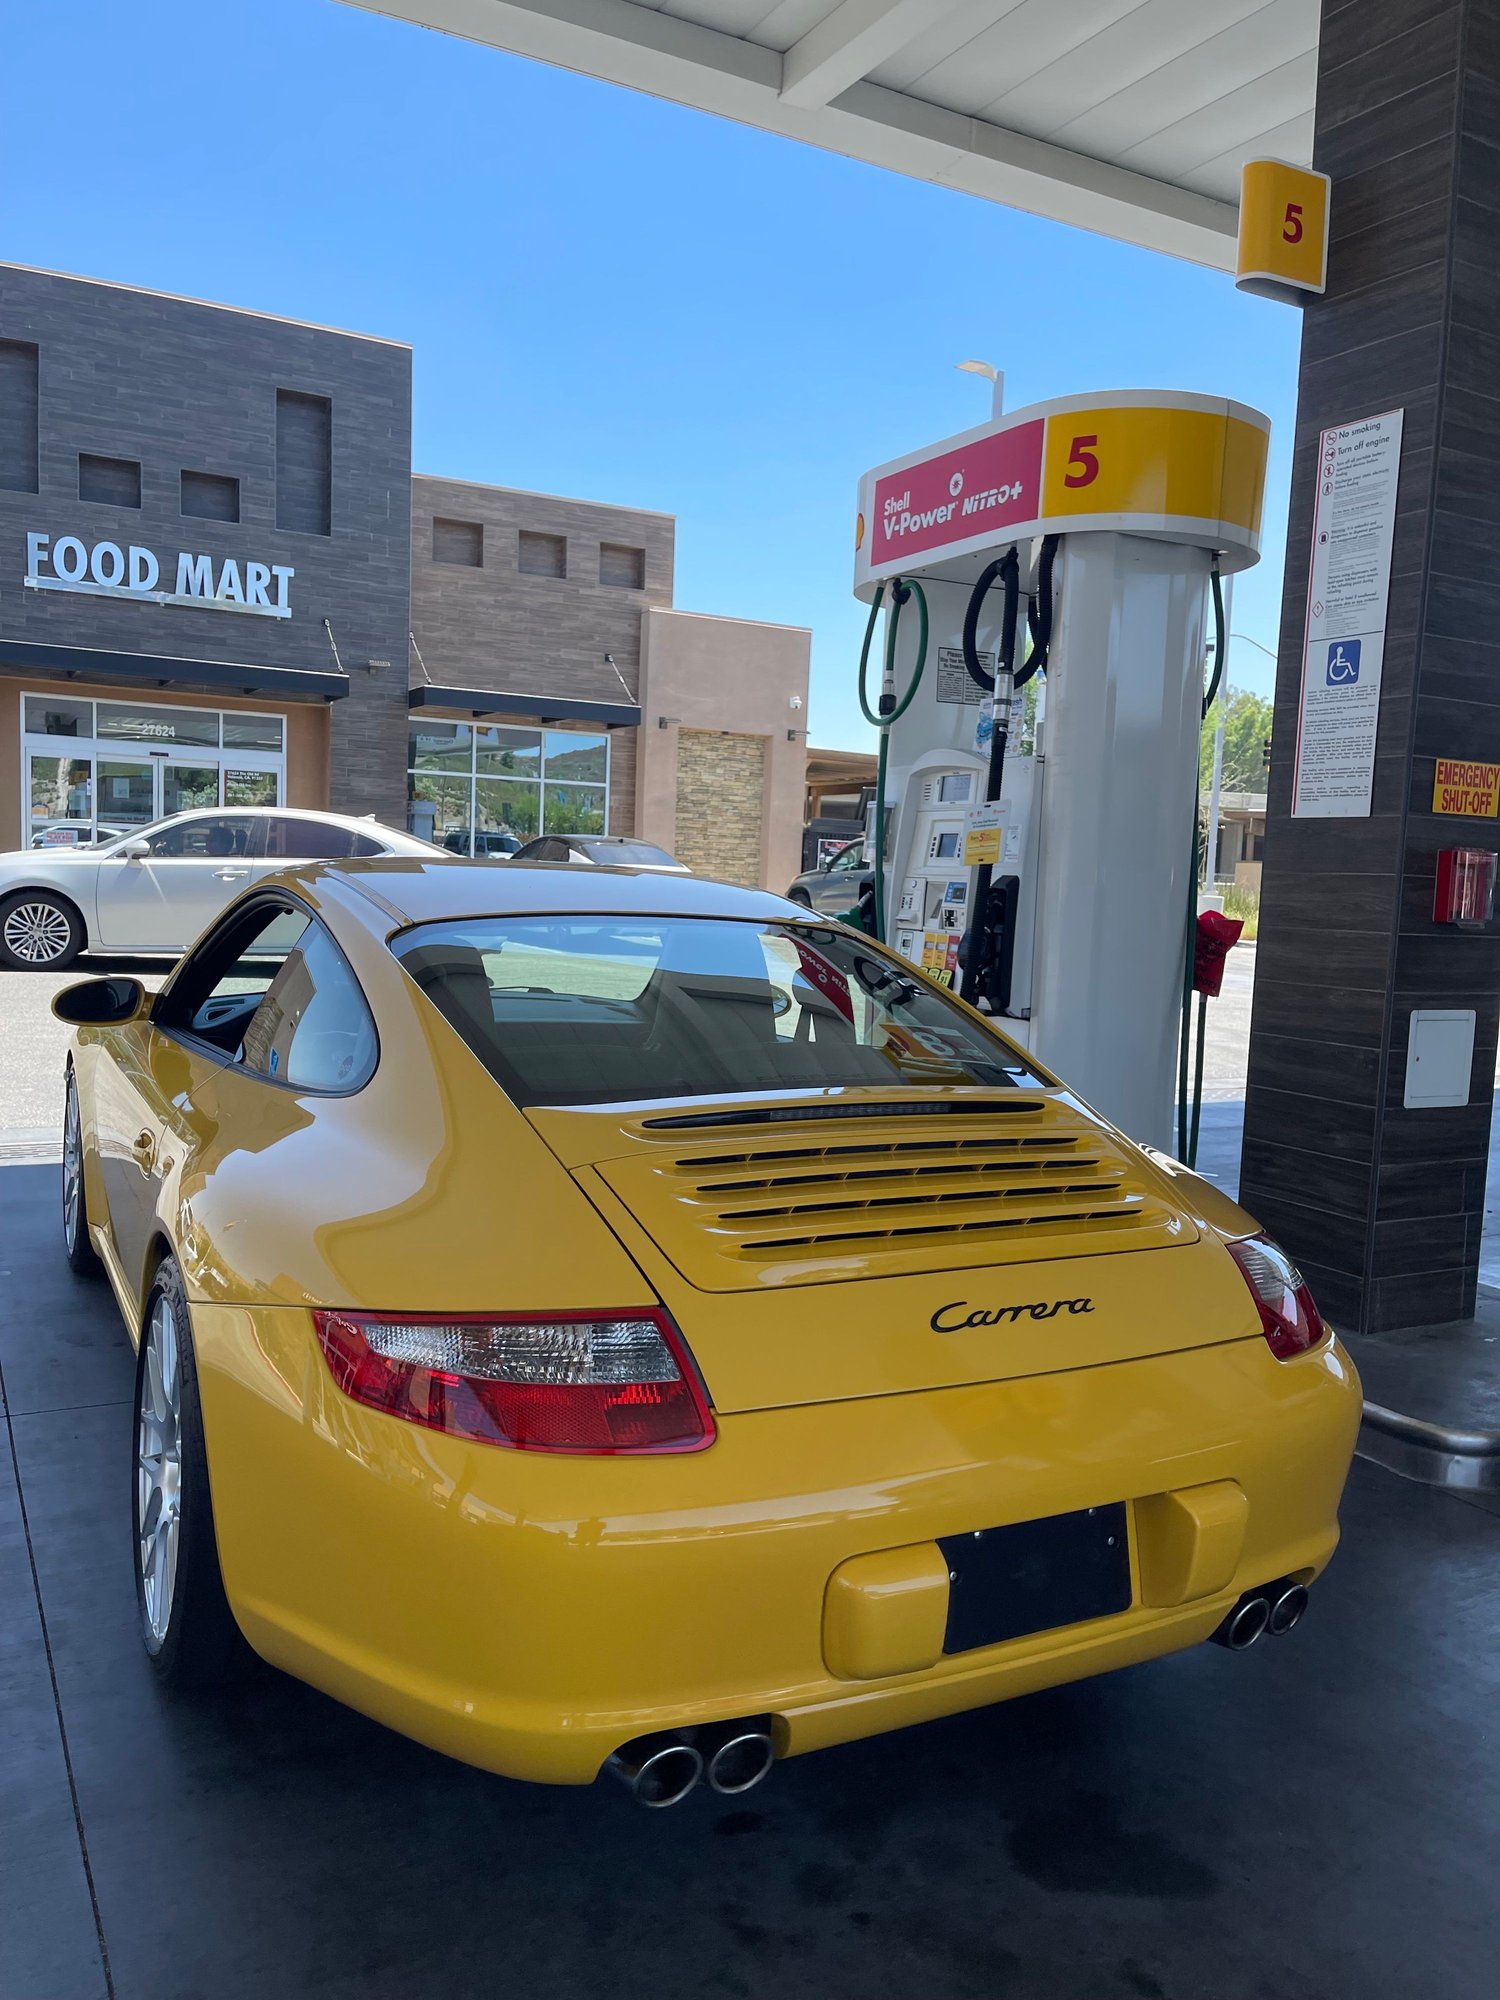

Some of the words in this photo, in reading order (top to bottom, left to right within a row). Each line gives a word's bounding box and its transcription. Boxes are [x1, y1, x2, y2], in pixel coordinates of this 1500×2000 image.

[1282, 203, 1303, 244] 5
[1339, 431, 1350, 440] No
[1351, 422, 1381, 437] smoking
[1338, 447, 1352, 456] Turn
[1354, 440, 1365, 451] off
[1366, 436, 1390, 448] engine
[1064, 435, 1099, 488] 5
[884, 491, 910, 515] Shell
[883, 501, 956, 540] V-Power
[26, 531, 160, 592] FOOD
[175, 552, 295, 610] MART
[141, 723, 176, 739] 27624
[1437, 762, 1499, 789] EMERGENCY
[1442, 789, 1493, 814] SHUT-OFF
[930, 1298, 1095, 1333] Carrera
